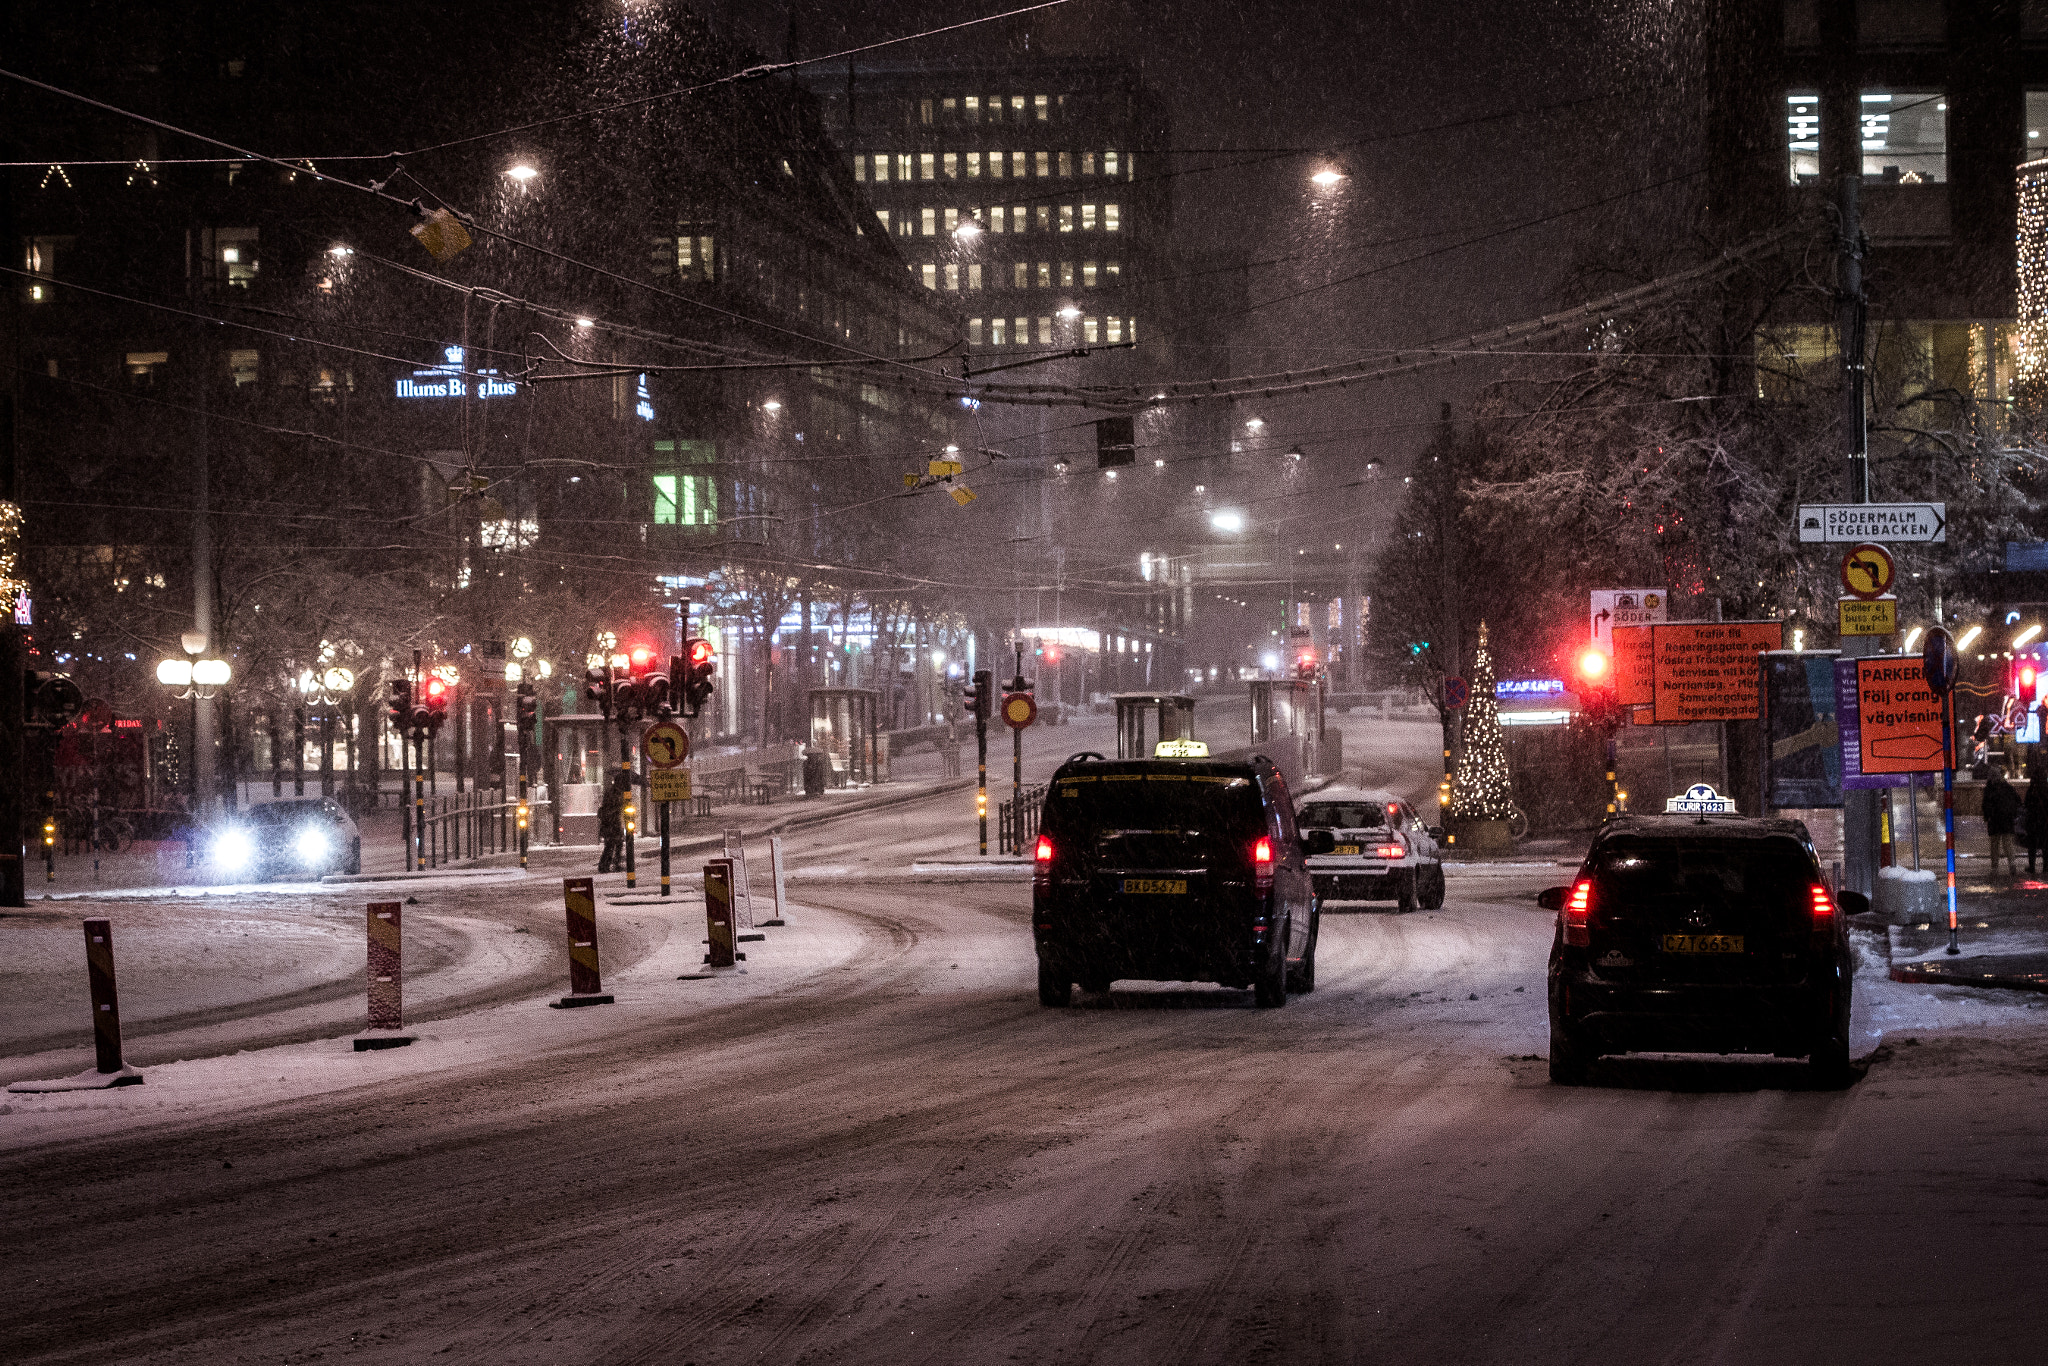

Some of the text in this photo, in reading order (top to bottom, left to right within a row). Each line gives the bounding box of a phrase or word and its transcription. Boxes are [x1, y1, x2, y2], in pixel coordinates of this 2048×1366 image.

[396, 379, 447, 398] Illums
[1829, 511, 1916, 524] SÖDERMALM
[1829, 524, 1928, 536] TEGELBACKEN
[1843, 603, 1885, 614] Gäller ej
[1614, 611, 1658, 622] SÖDER-
[1845, 614, 1888, 623] buss och
[1855, 623, 1875, 631] taxi
[1695, 628, 1741, 638] Trafik till
[1665, 641, 1771, 653] Regeringsgatan och
[1696, 654, 1758, 665] Trädgårdsg
[1672, 667, 1720, 677] hänvisas
[1863, 689, 1890, 705] Följ
[1895, 691, 1940, 704] orang
[1677, 802, 1724, 812] KURIR 3623
[1126, 879, 1176, 892] BKD567
[1665, 936, 1730, 951] CZT665
